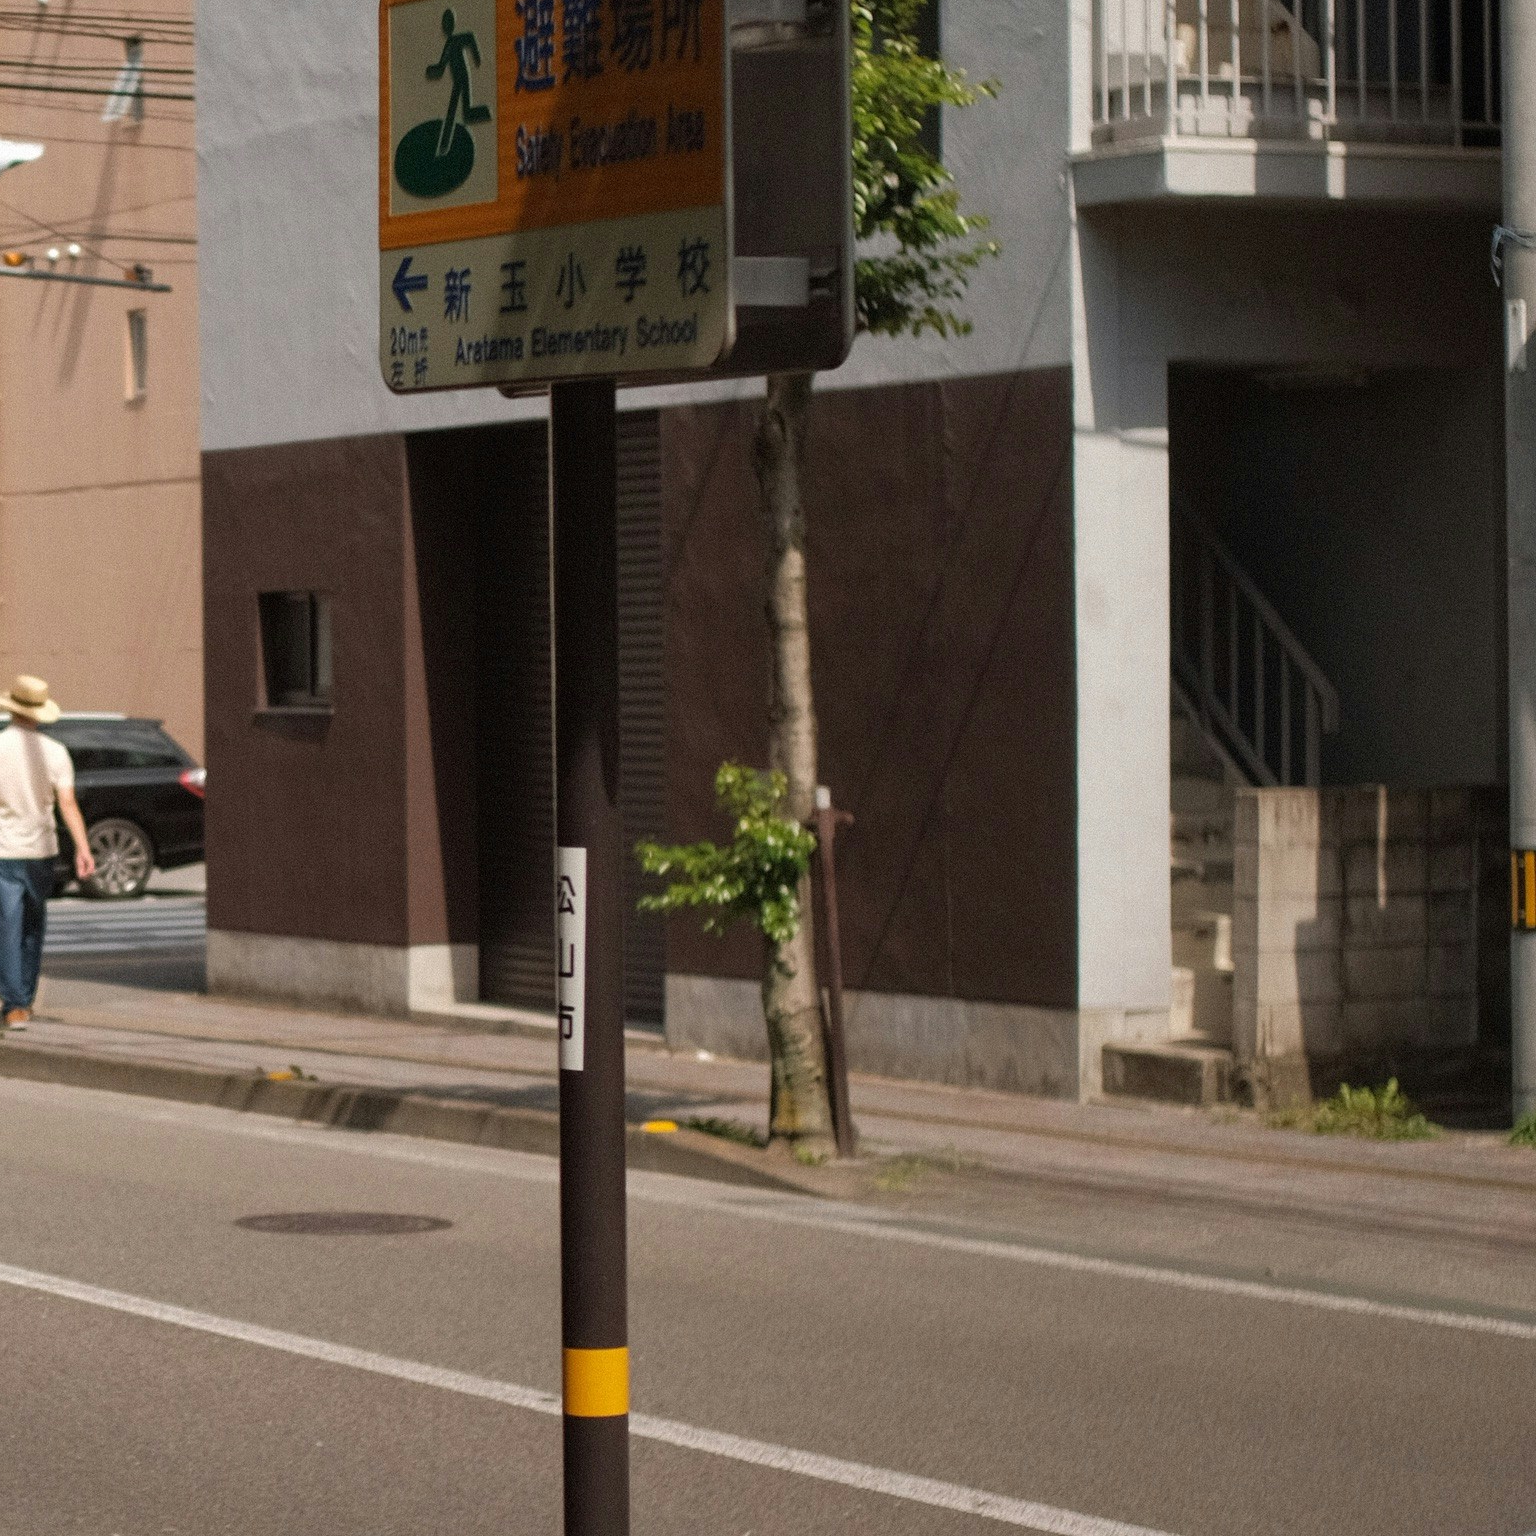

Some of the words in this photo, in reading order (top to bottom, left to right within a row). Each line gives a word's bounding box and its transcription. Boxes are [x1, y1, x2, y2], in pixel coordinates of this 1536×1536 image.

[516, 123, 562, 181] Safety
[444, 237, 712, 323] 新玉小学校
[454, 336, 524, 365] Aratama
[531, 325, 629, 357] Elementary
[636, 314, 697, 347] School
